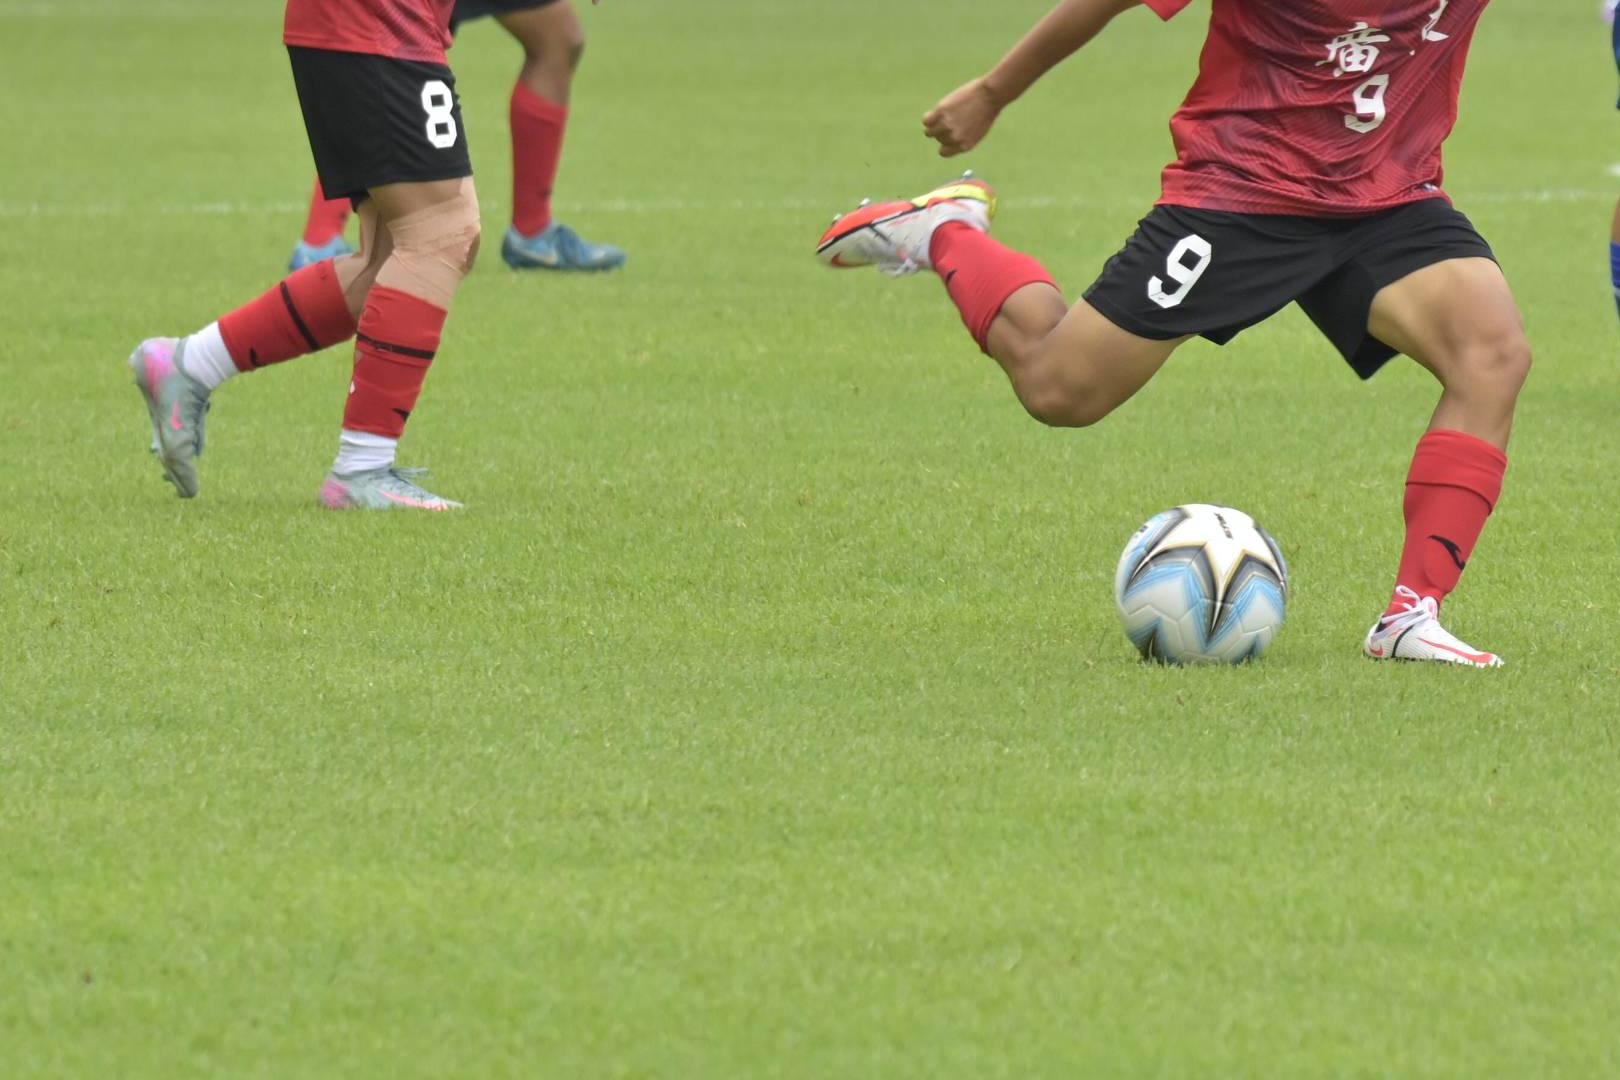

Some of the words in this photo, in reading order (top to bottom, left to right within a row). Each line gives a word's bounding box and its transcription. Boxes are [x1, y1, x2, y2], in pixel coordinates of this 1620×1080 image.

[420, 79, 458, 149] 8
[1344, 73, 1390, 134] 9
[1147, 233, 1213, 309] 9
